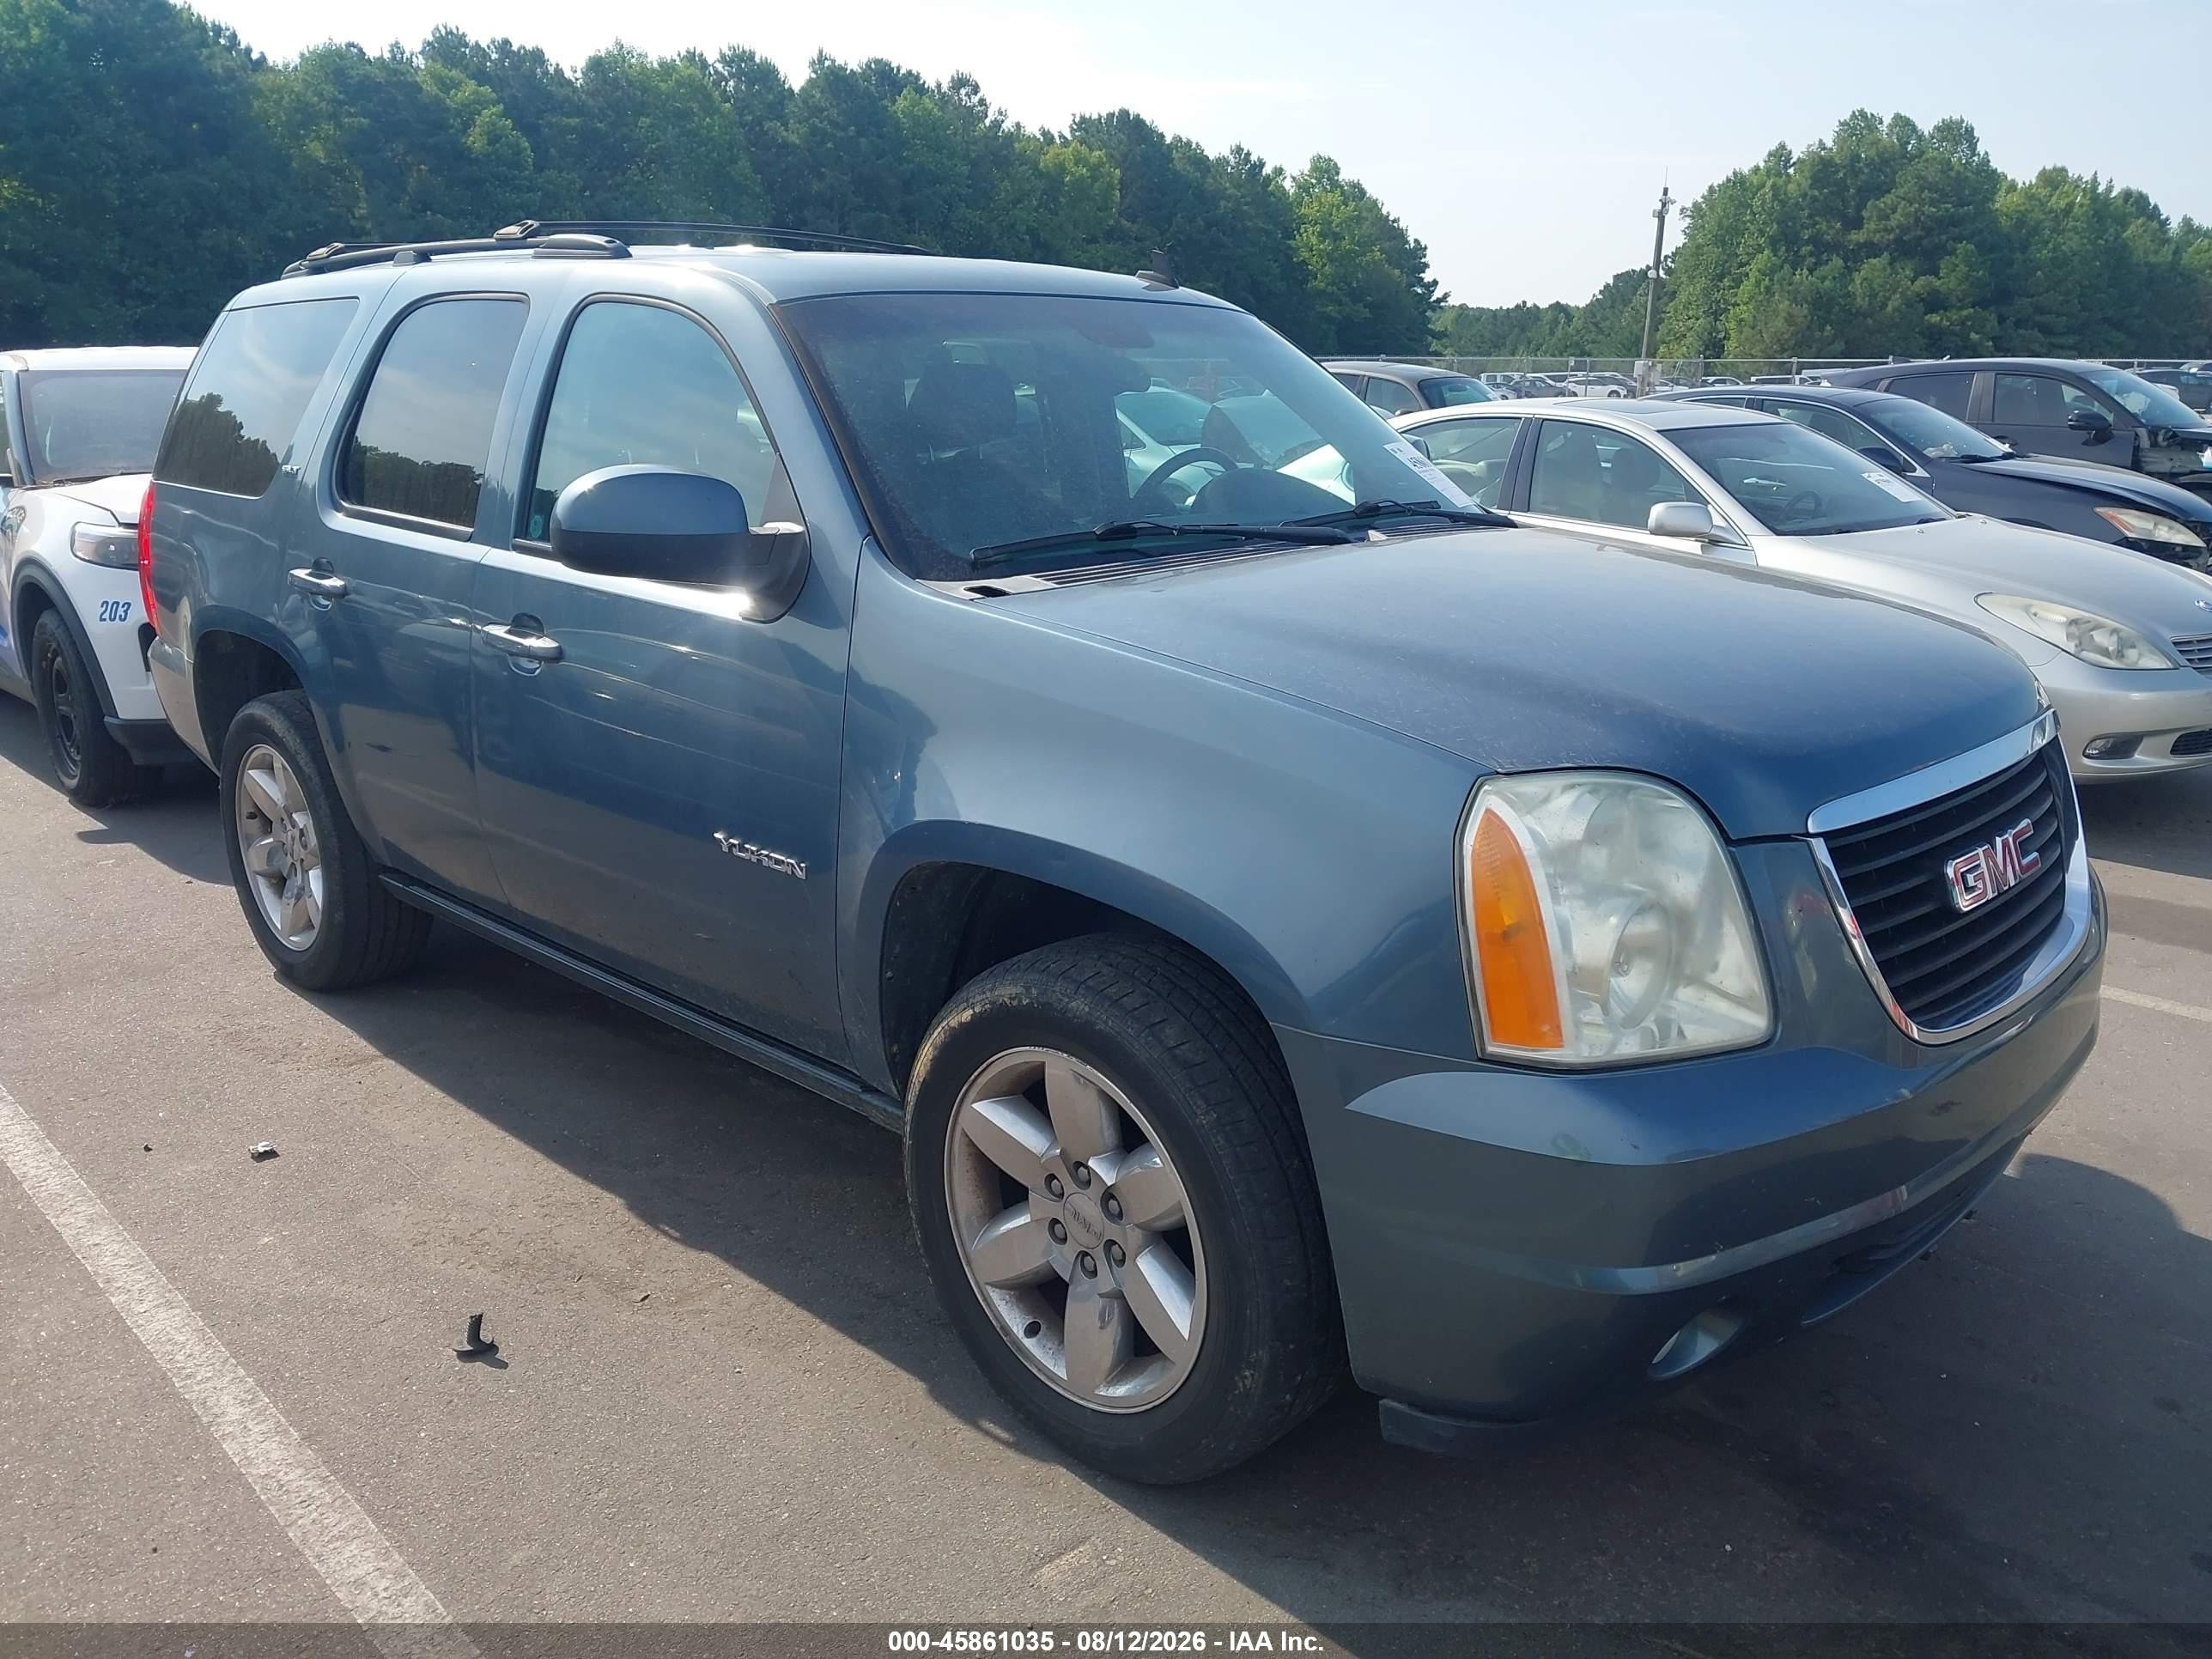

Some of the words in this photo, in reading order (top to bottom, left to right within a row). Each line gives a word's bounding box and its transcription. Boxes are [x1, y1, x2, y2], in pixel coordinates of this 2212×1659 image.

[98, 599, 132, 623] 203
[713, 831, 807, 880] YUKON
[1944, 817, 2042, 914] GMC
